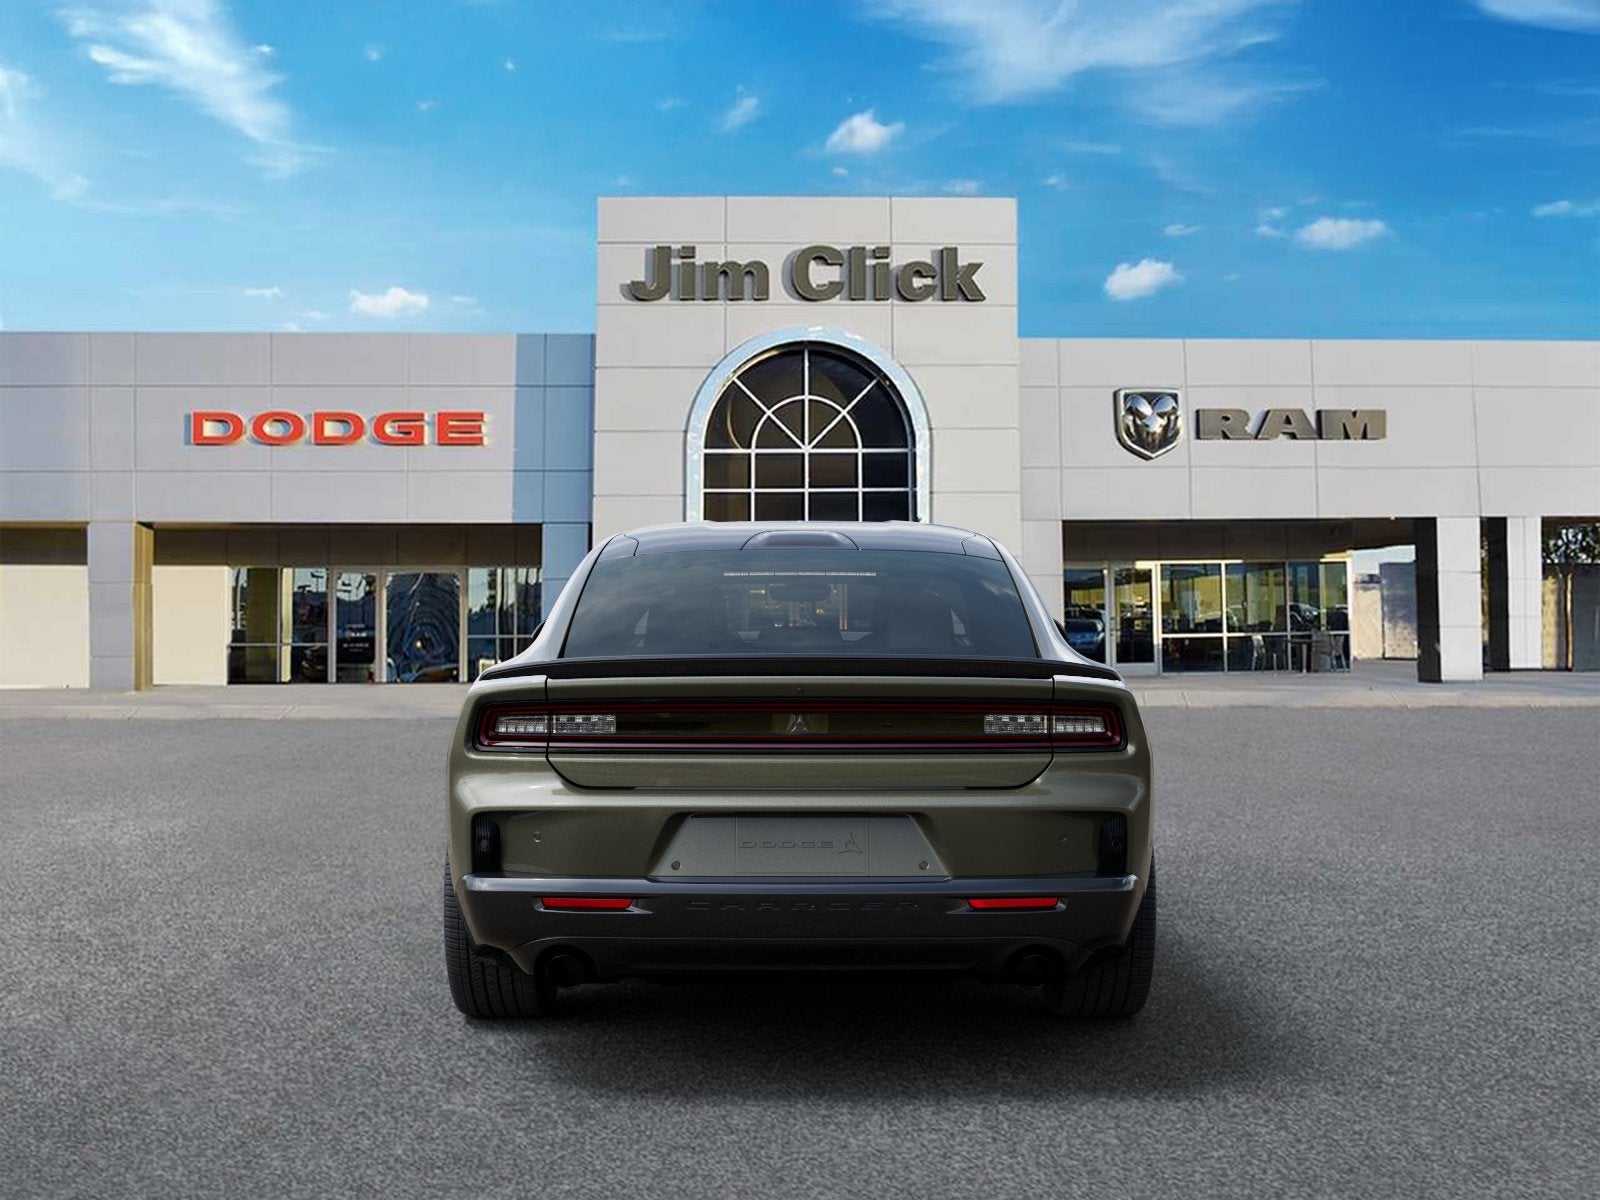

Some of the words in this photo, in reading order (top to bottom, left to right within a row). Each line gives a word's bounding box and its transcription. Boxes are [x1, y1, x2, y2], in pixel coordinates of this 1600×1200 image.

[629, 245, 770, 302] Jim
[793, 245, 986, 302] Click
[190, 411, 487, 446] DODGE
[1195, 409, 1387, 440] RAM
[738, 839, 835, 850] DODGE
